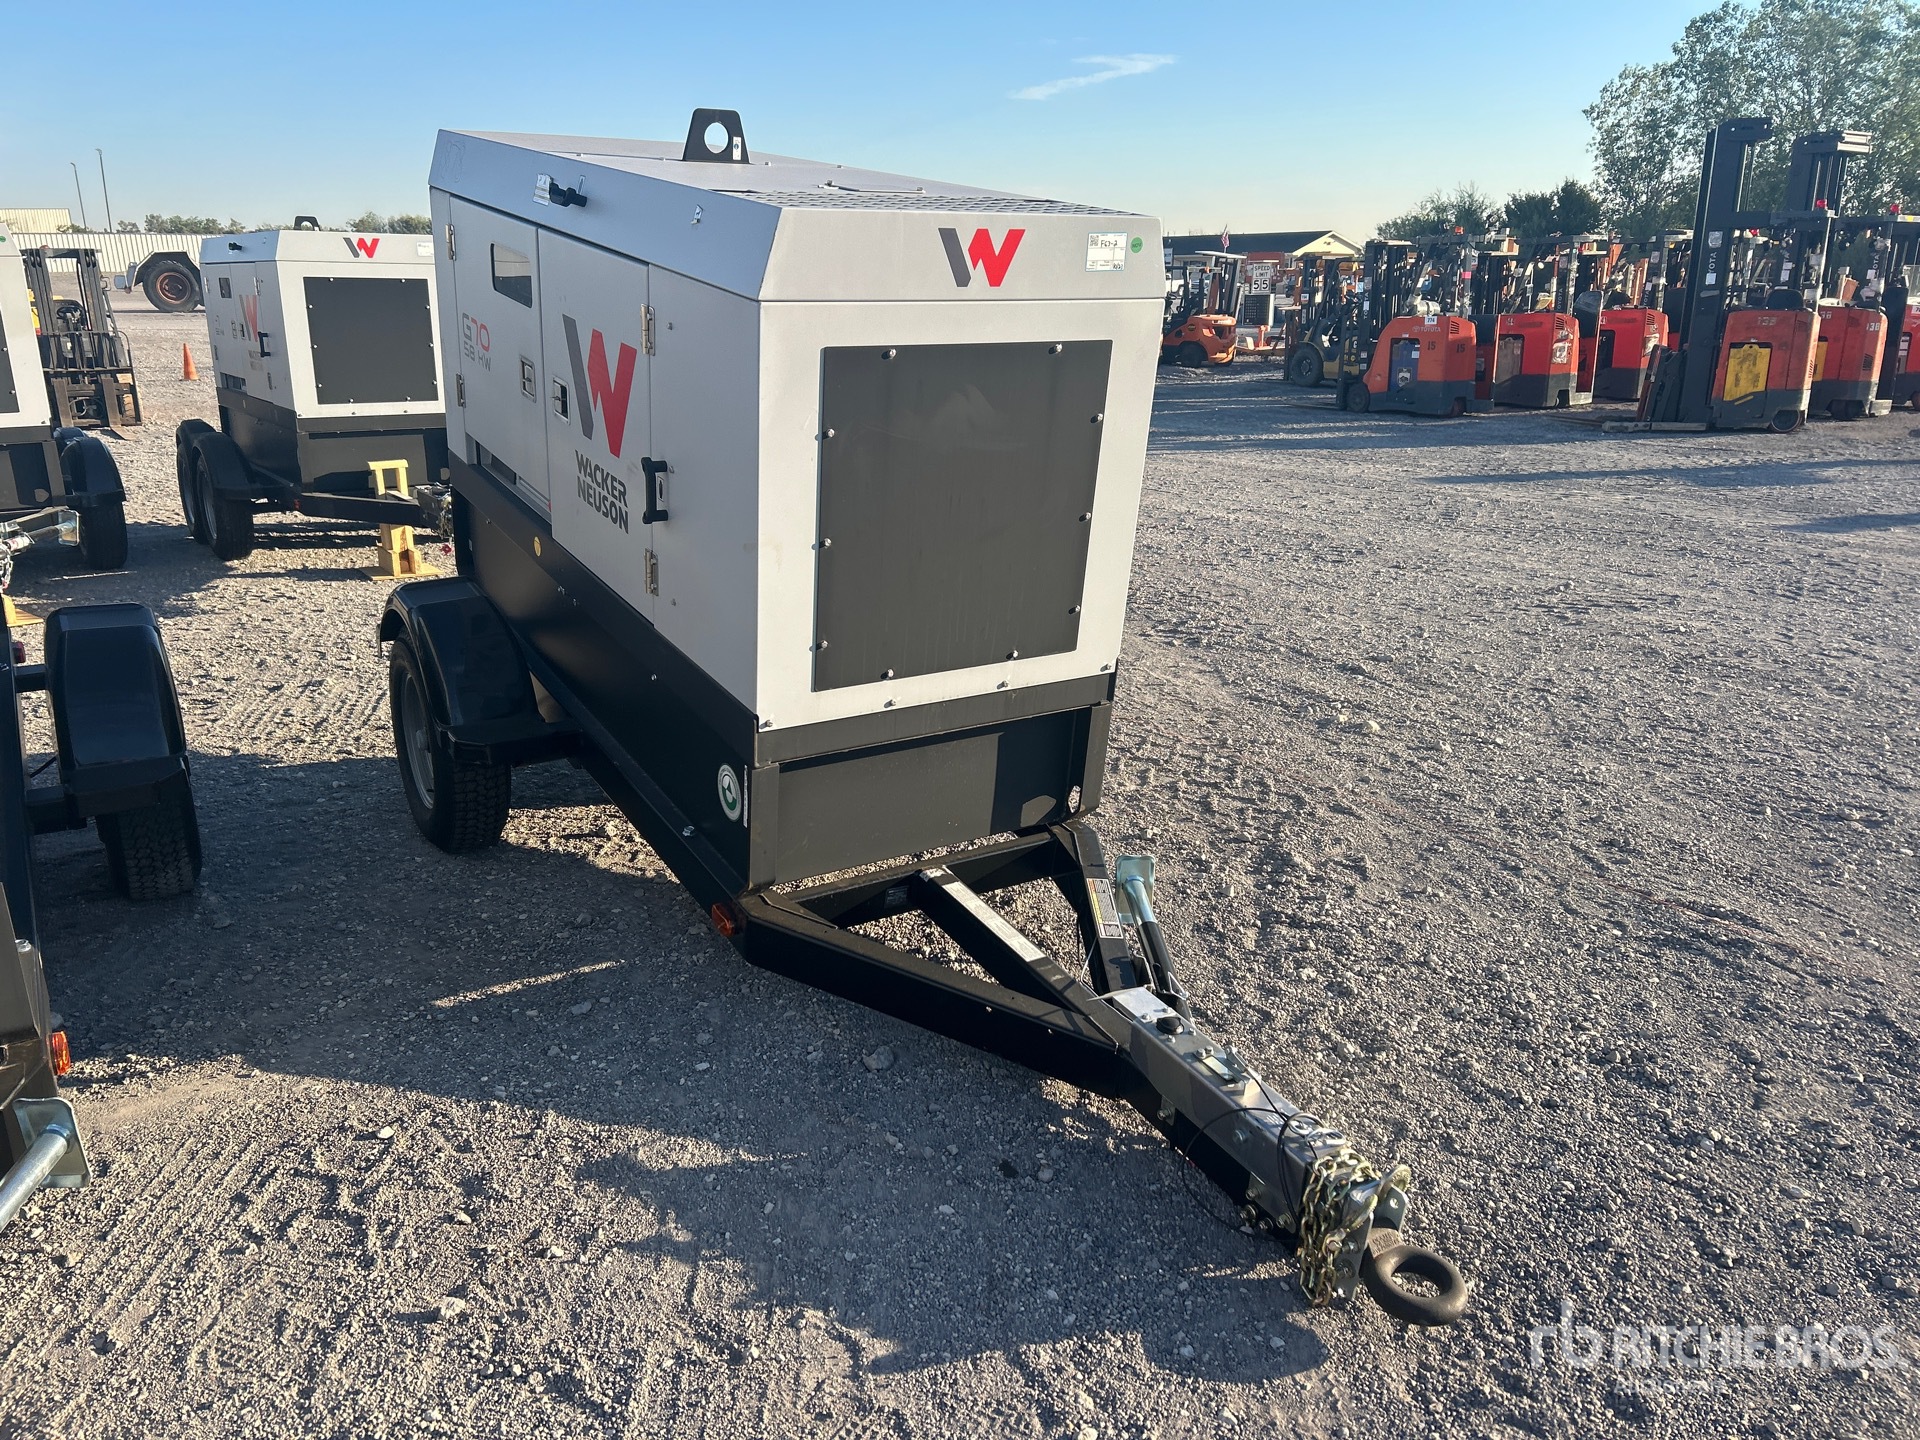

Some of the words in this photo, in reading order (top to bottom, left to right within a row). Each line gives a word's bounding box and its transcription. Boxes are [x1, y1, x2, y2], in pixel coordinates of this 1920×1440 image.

[1253, 279, 1269, 290] 55
[462, 312, 491, 352] G70
[575, 449, 629, 508] WACKER
[577, 475, 629, 534] NEUSON
